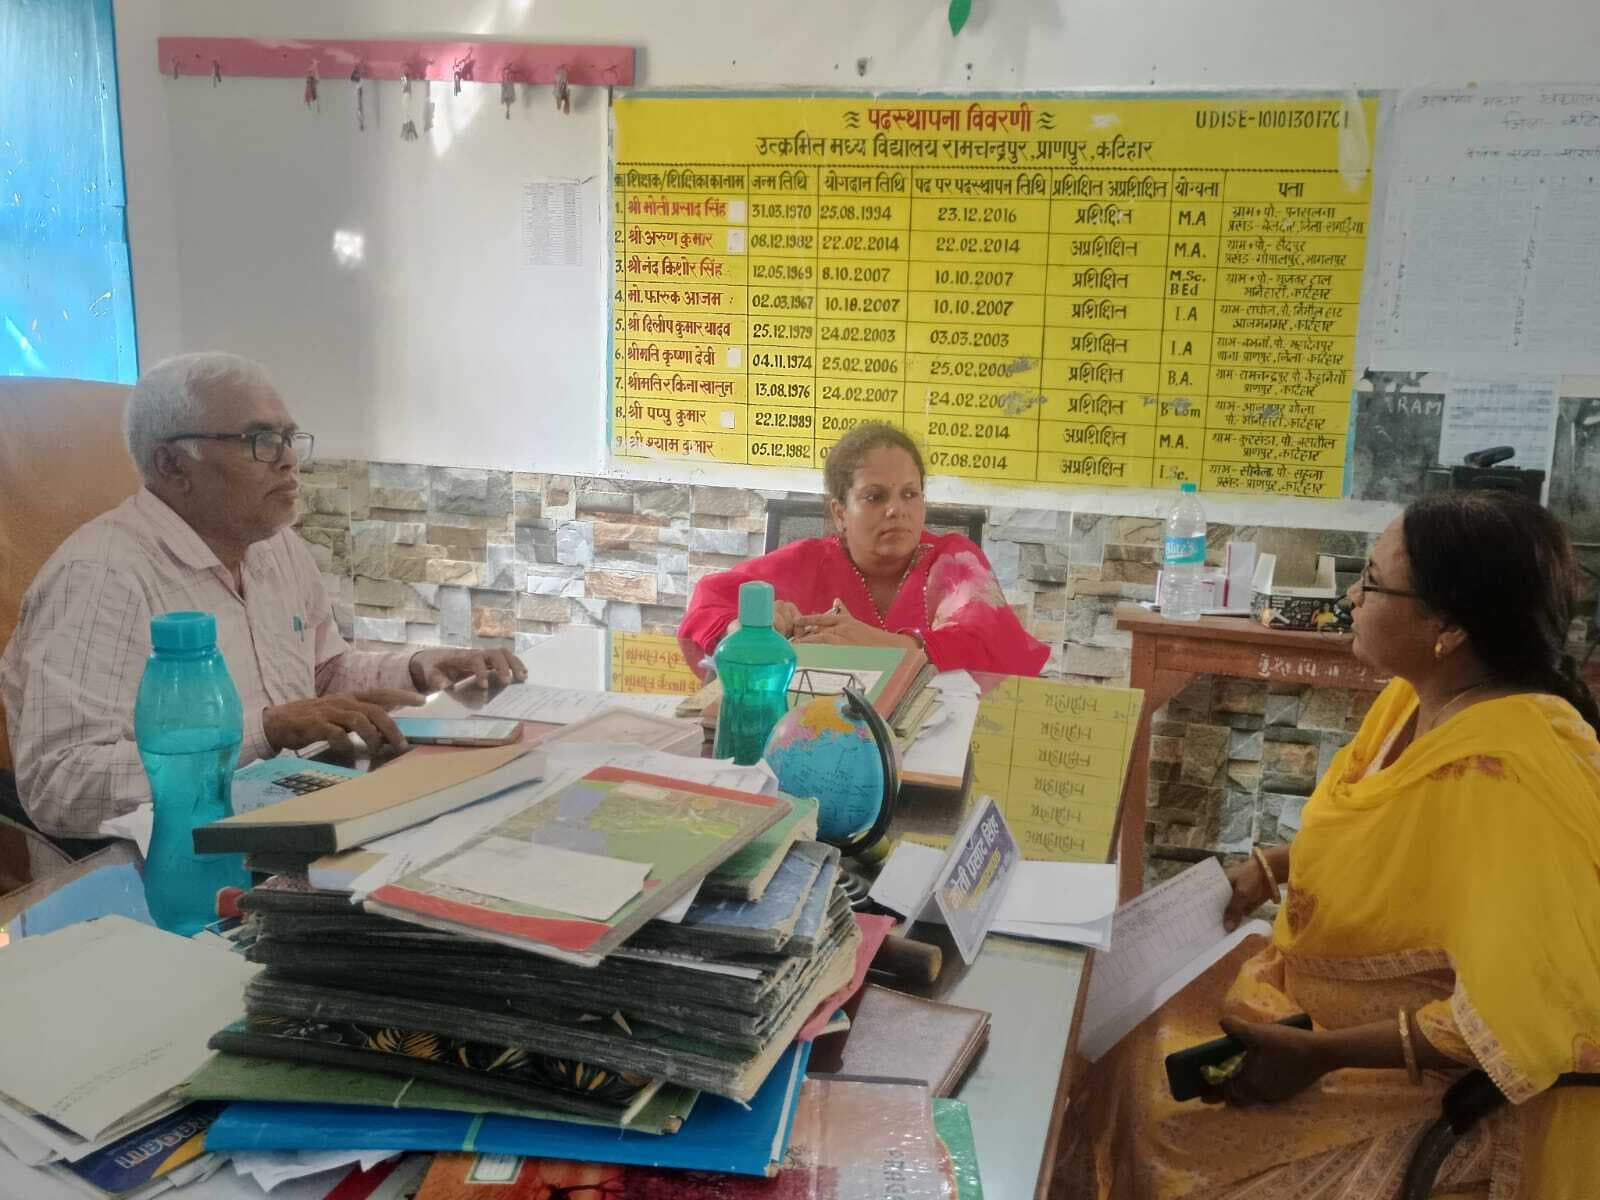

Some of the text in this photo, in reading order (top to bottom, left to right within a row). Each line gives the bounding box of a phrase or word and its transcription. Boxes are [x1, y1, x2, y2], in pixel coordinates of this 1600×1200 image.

[967, 102, 1034, 133] विवरणी
[756, 129, 828, 158] उत्क्रमित
[830, 137, 869, 158] मध्य
[873, 132, 940, 158] विद्यालय
[751, 169, 810, 191] जन्म तिथि
[875, 171, 907, 193] तिथि
[935, 178, 952, 194] पर
[1016, 172, 1047, 196] तिथि
[1052, 173, 1169, 199] प्रशिक्षित अप्रशिक्षित
[627, 195, 641, 215] श्री
[819, 205, 892, 221] 25.08.1994
[938, 207, 1017, 223] 23.12.2016
[614, 231, 624, 243] 2.
[628, 223, 642, 245] श्री
[680, 231, 714, 249] कुमार
[822, 236, 900, 252] 22.02.2014
[936, 237, 1021, 253] 22.02.2014
[1072, 235, 1139, 257] अप्रशिक्षित
[615, 260, 624, 272] 3.
[627, 254, 641, 274] श्री
[700, 255, 724, 278] सिंह
[822, 267, 890, 282] 8.10.2007
[935, 270, 1014, 286] 10.10.2007
[1072, 267, 1129, 290] प्रशिक्षित
[615, 290, 624, 302] 4.
[685, 291, 724, 306] आजम
[934, 299, 1014, 316] 10.10.2007
[1072, 298, 1128, 320] प्रशिक्षित
[615, 319, 624, 332] 5.
[627, 313, 641, 332] श्री
[642, 313, 674, 333] दिलीप
[675, 320, 704, 338] कुमार
[820, 326, 896, 343] 24.02.2003
[930, 329, 1010, 347] 03.03.2003
[1071, 332, 1129, 355] प्रशिक्षित
[615, 348, 624, 361] 6.
[662, 347, 693, 367] कृष्णा
[695, 344, 716, 366] देवी
[752, 354, 812, 369] 04.11.1974
[822, 357, 898, 373] 25.02.2006
[1068, 362, 1125, 384] प्रशिक्षित
[615, 376, 624, 389] 7.
[755, 383, 810, 398] 13.08.1976
[822, 386, 898, 402] 24.02.2007
[929, 391, 1013, 408] 24.02.200
[615, 407, 625, 418] 8.
[1067, 393, 1127, 416] प्रशिक्षित
[628, 400, 643, 419] श्री
[676, 409, 708, 427] कुमार
[755, 412, 812, 429] 22.12.1989
[928, 421, 1010, 439] 20.02.2014
[1064, 424, 1128, 447] अप्रशिक्षित
[1159, 434, 1189, 449] M.A.
[752, 443, 811, 459] 05.12.1982
[930, 452, 1008, 470] 07.08.2014
[1061, 456, 1126, 478] अप्रशिक्षित
